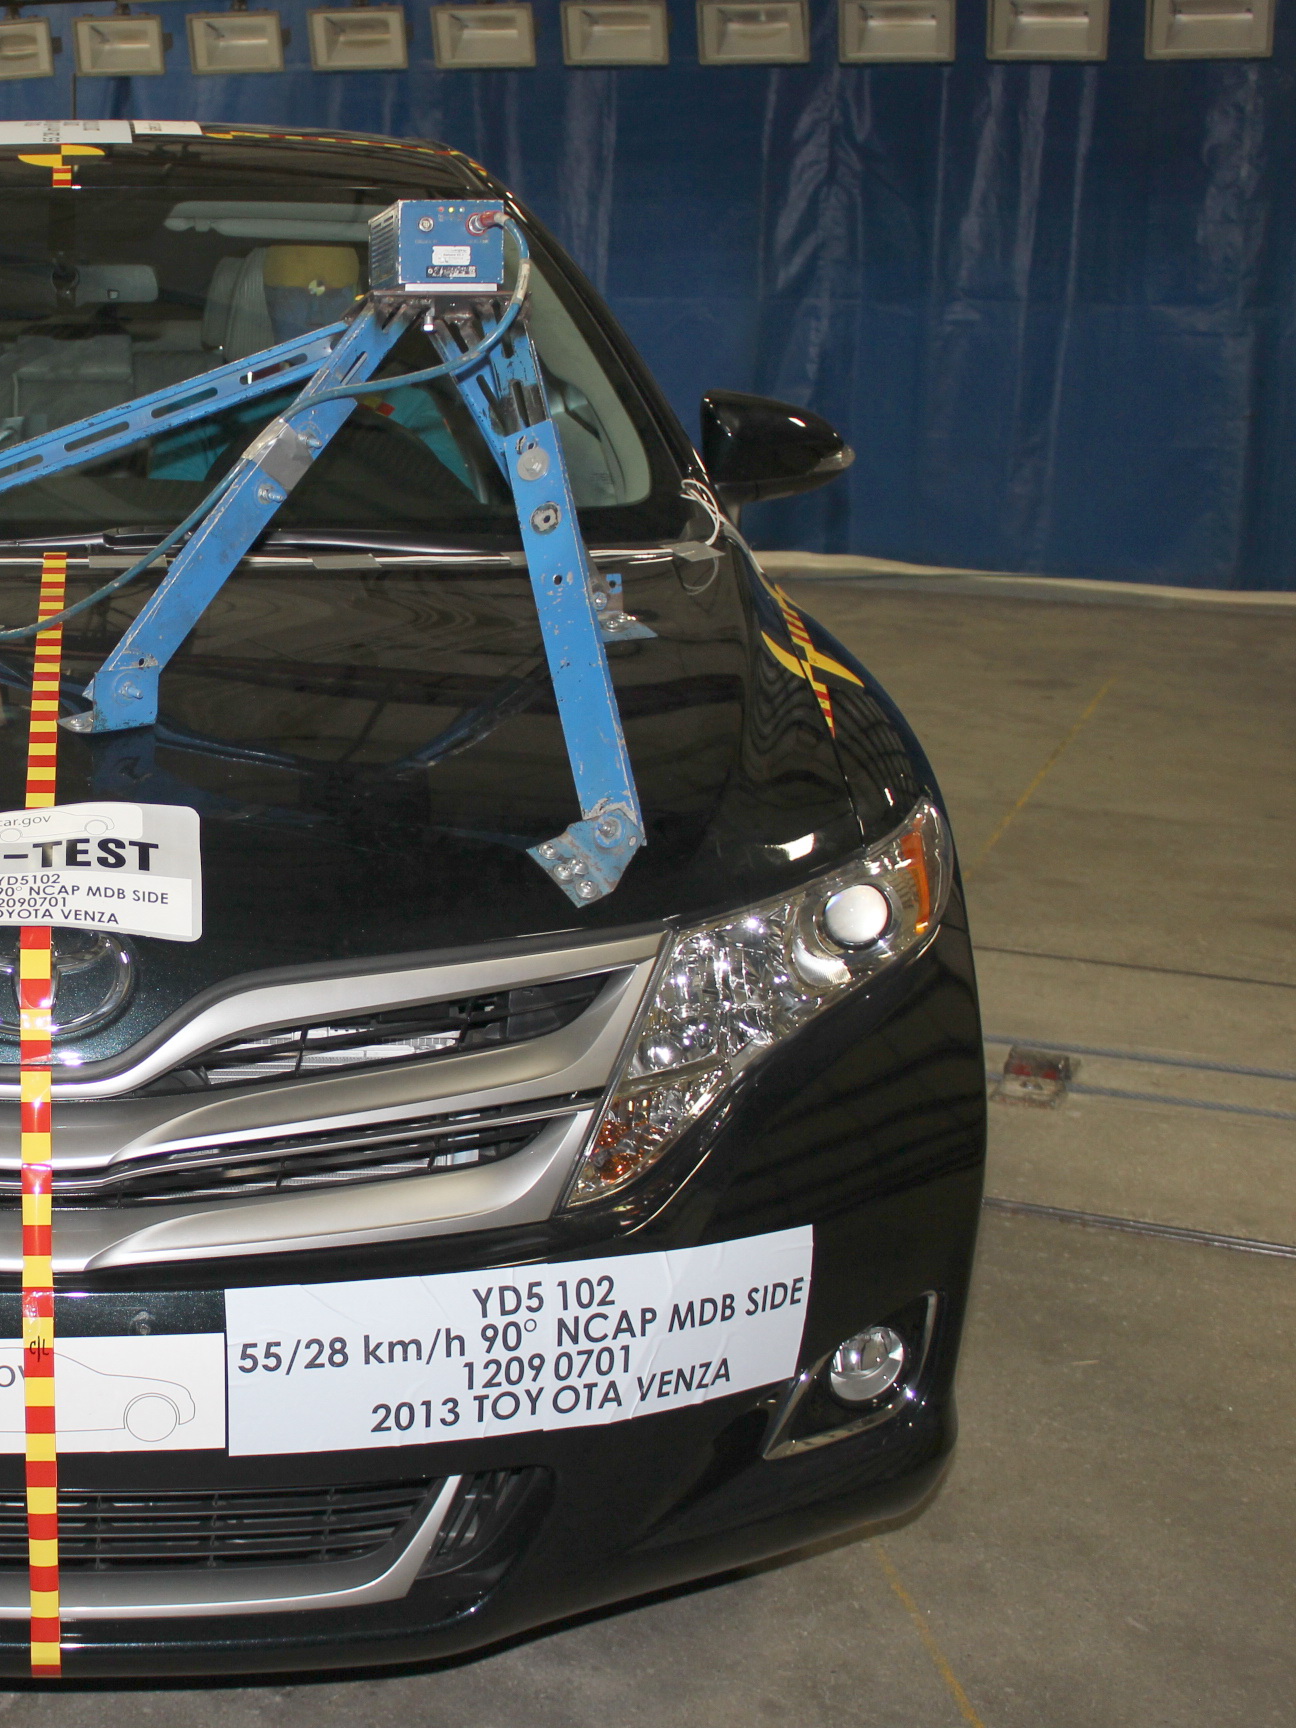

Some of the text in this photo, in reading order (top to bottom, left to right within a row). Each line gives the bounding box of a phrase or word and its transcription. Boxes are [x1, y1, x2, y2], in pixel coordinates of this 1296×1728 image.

[29, 884, 81, 897] NCAP
[87, 886, 126, 900] MDB
[132, 890, 169, 905] SIDE
[61, 908, 119, 925] VENZA
[237, 1336, 350, 1375] 55/28
[363, 1327, 467, 1368] km/h
[556, 1307, 657, 1347] NCAP
[668, 1293, 736, 1333] MDB
[745, 1276, 804, 1316] SIDE
[370, 1357, 732, 1433] 2013 TOYOTA VENZA
